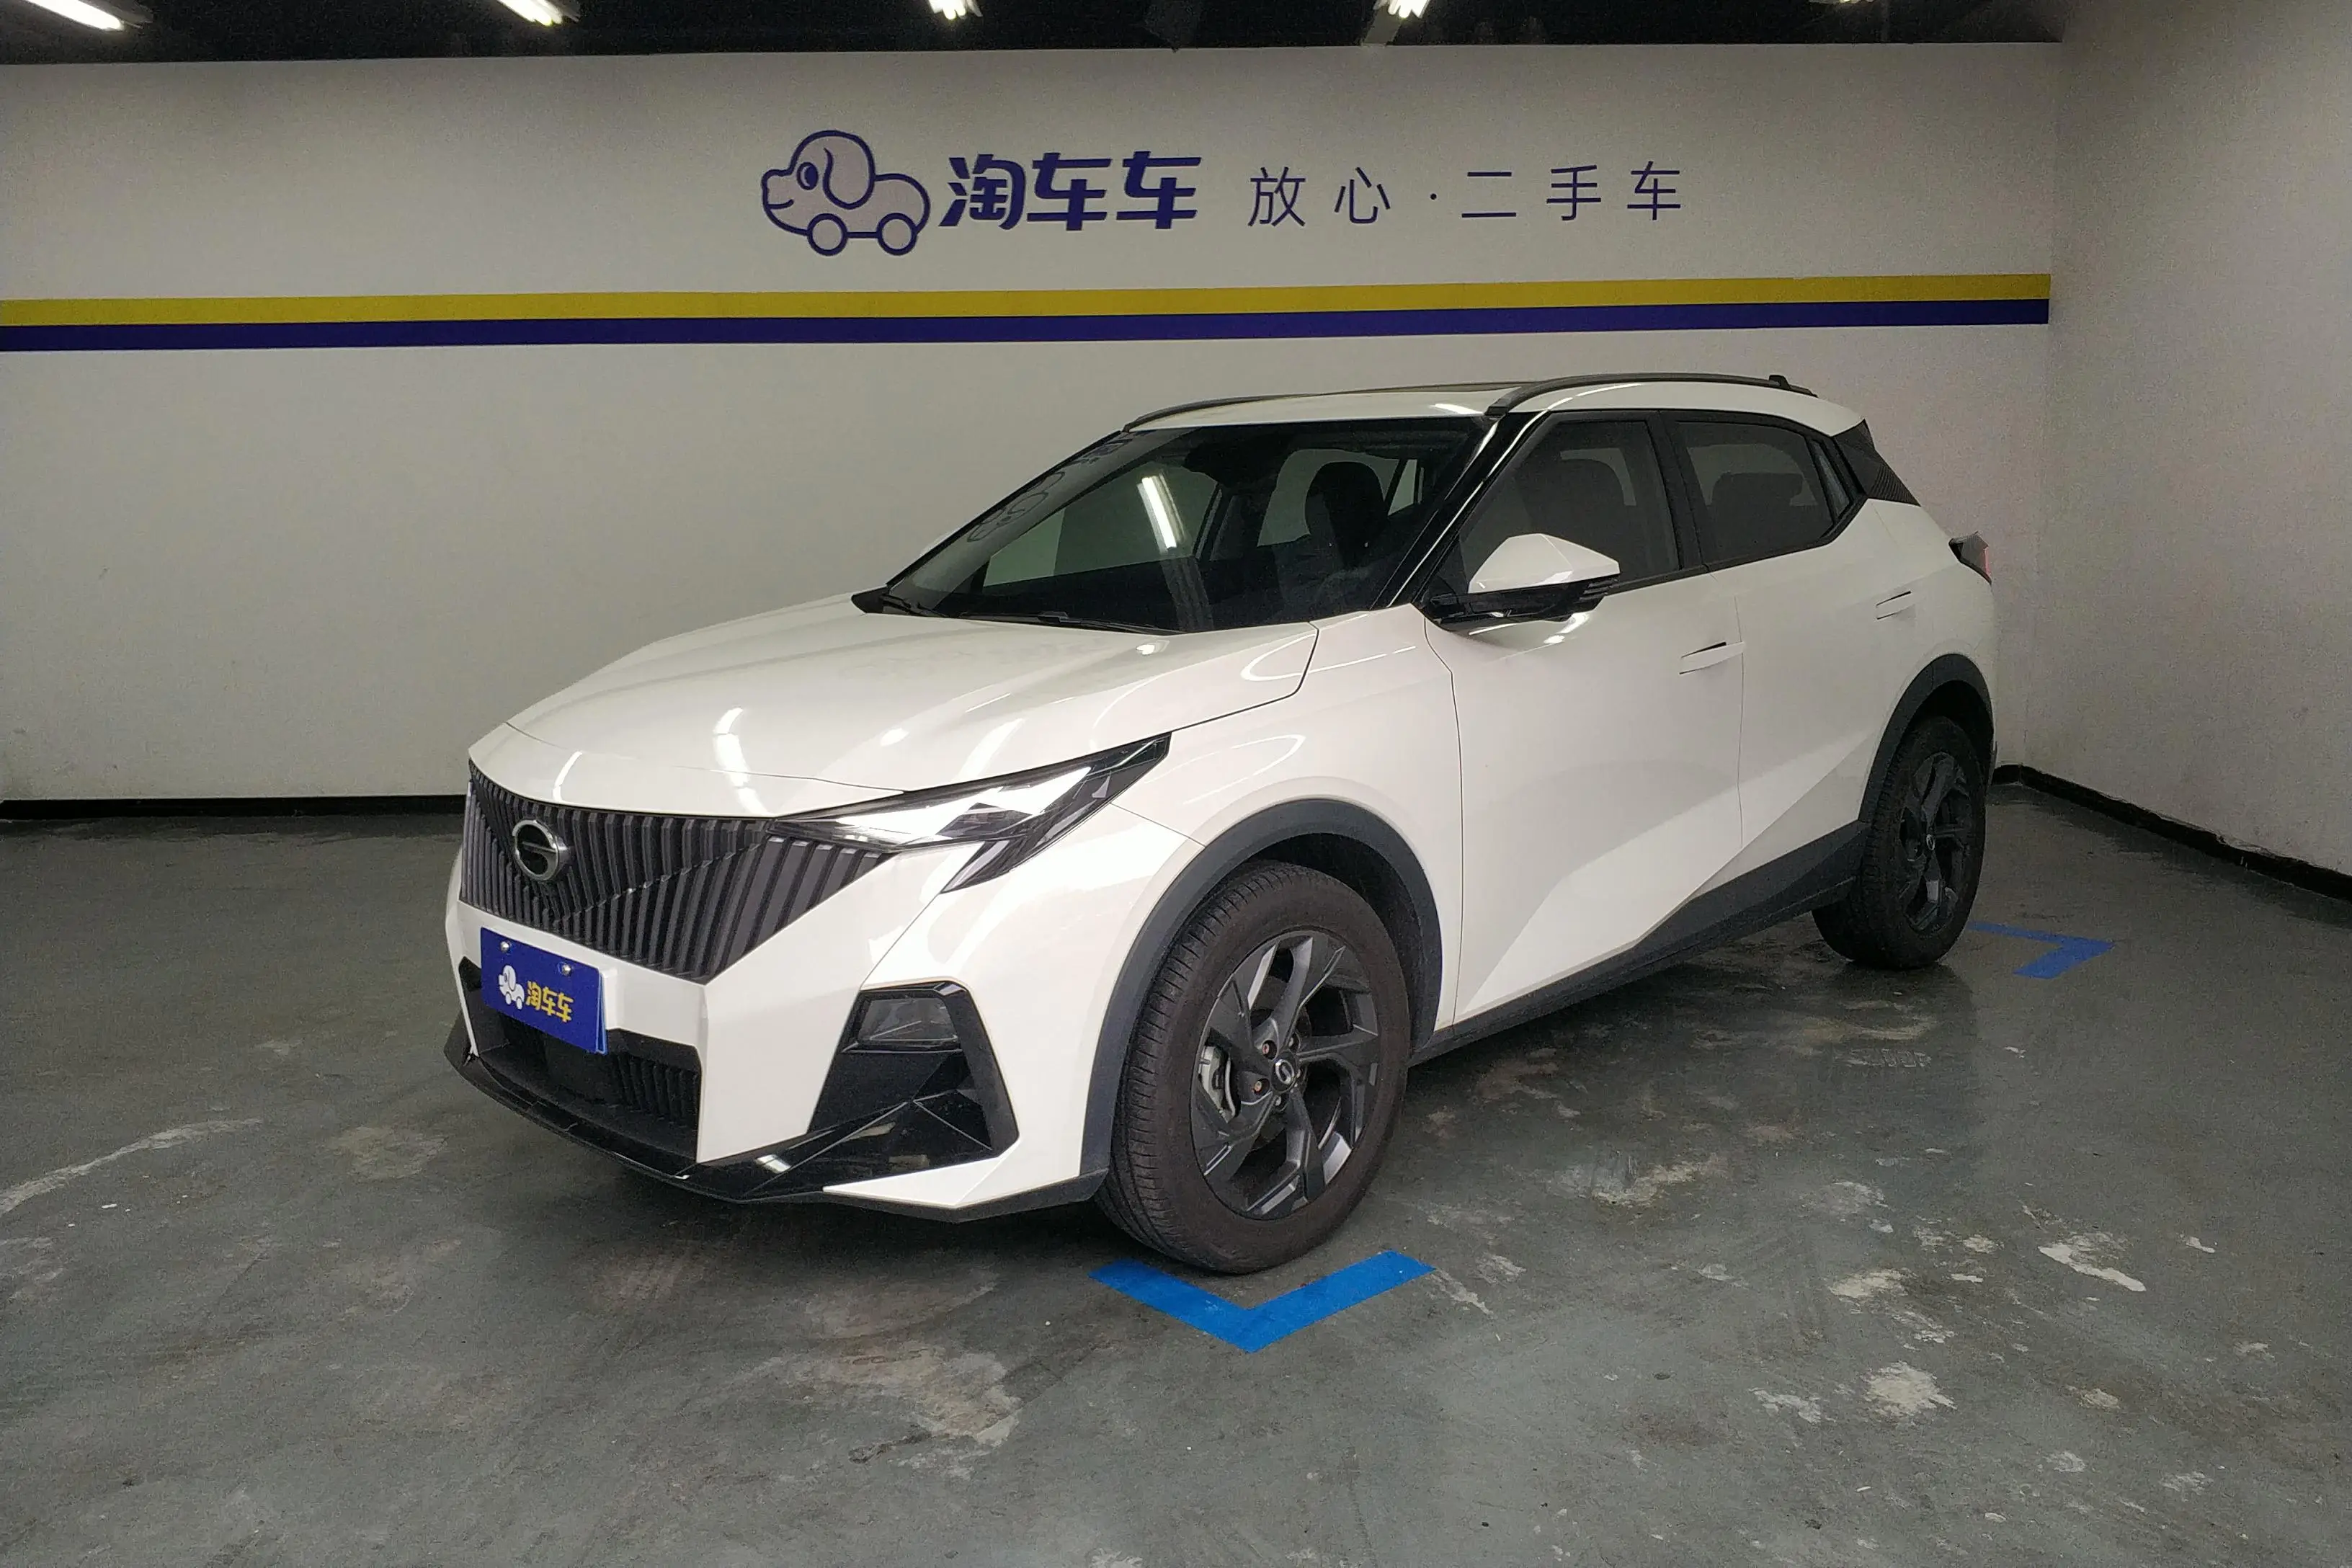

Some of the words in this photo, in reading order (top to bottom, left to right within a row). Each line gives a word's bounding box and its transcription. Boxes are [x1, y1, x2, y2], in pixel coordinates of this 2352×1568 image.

[938, 150, 1202, 231] 淘车车
[525, 981, 574, 1023] 淘车车
